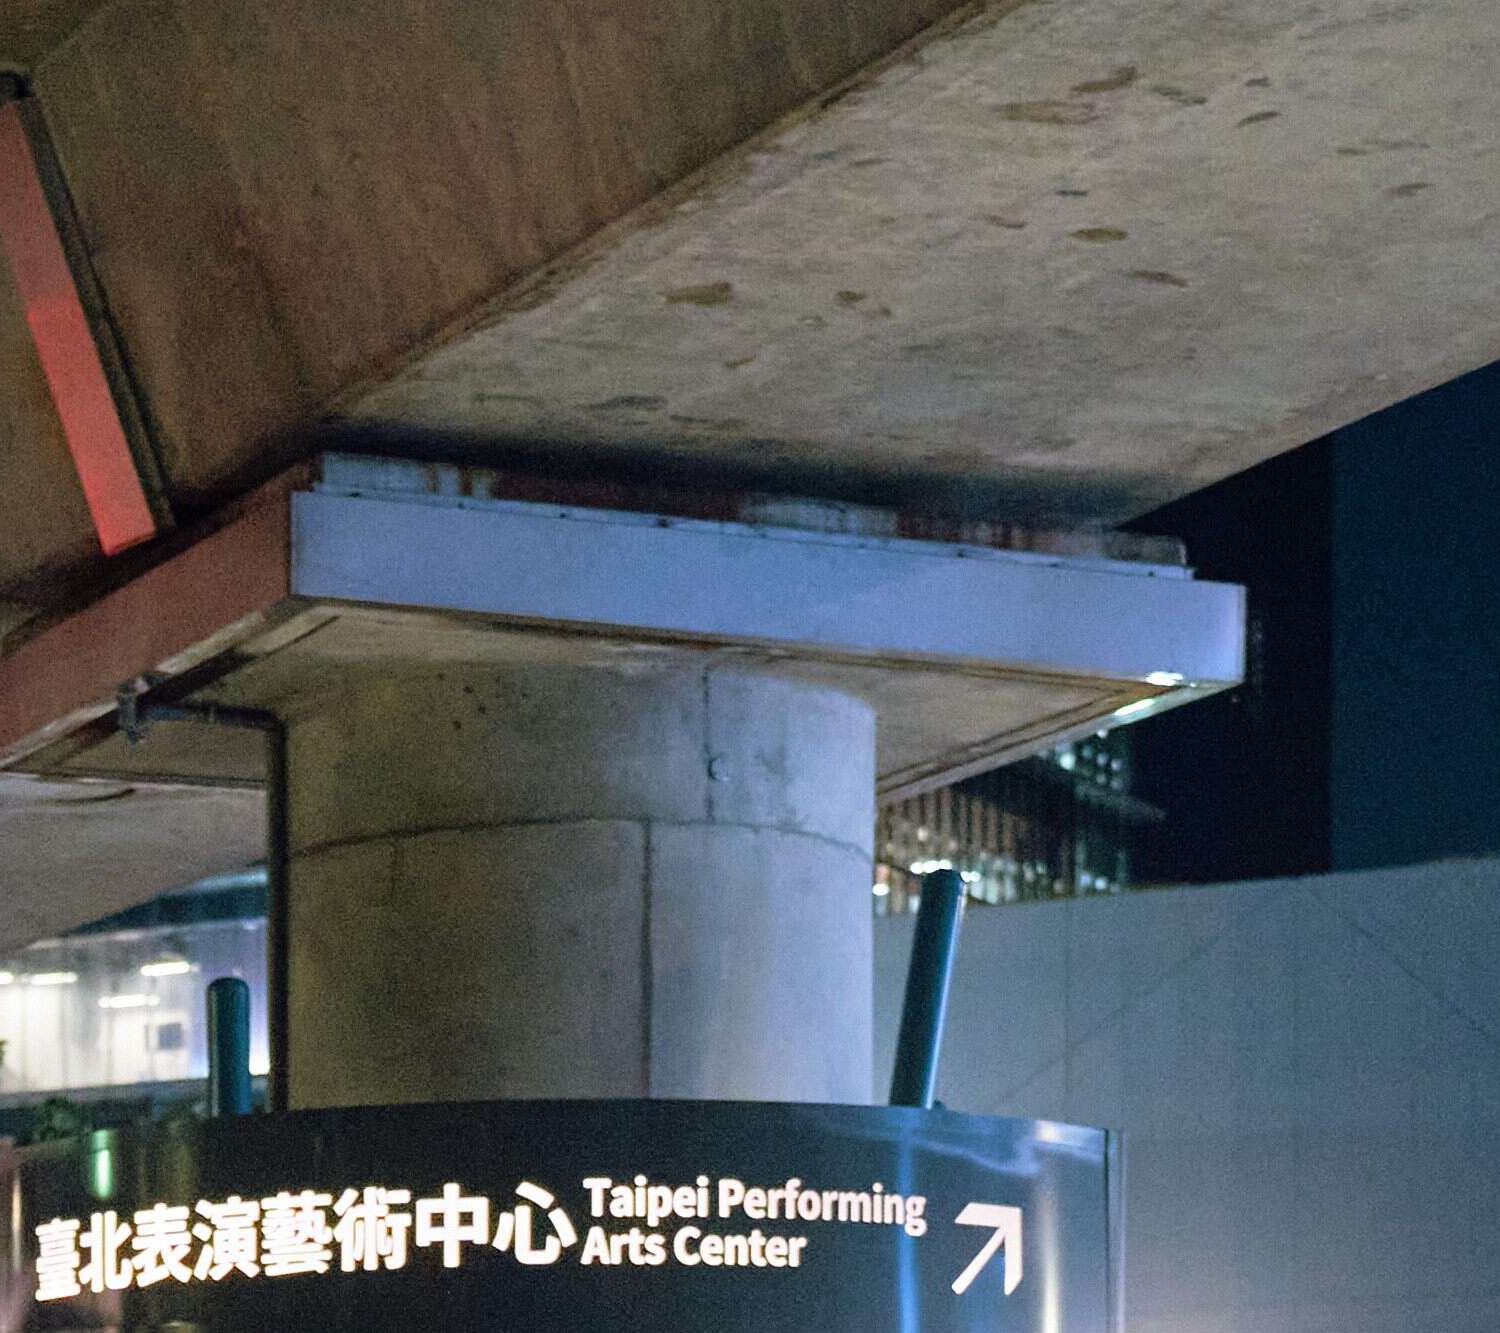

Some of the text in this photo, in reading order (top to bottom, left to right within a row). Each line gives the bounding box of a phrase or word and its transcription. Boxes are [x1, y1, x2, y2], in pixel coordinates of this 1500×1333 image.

[582, 1173, 928, 1238] Taipei Performing
[34, 1179, 578, 1303] 臺北表演藝術中心
[580, 1225, 808, 1268] Arts Center
